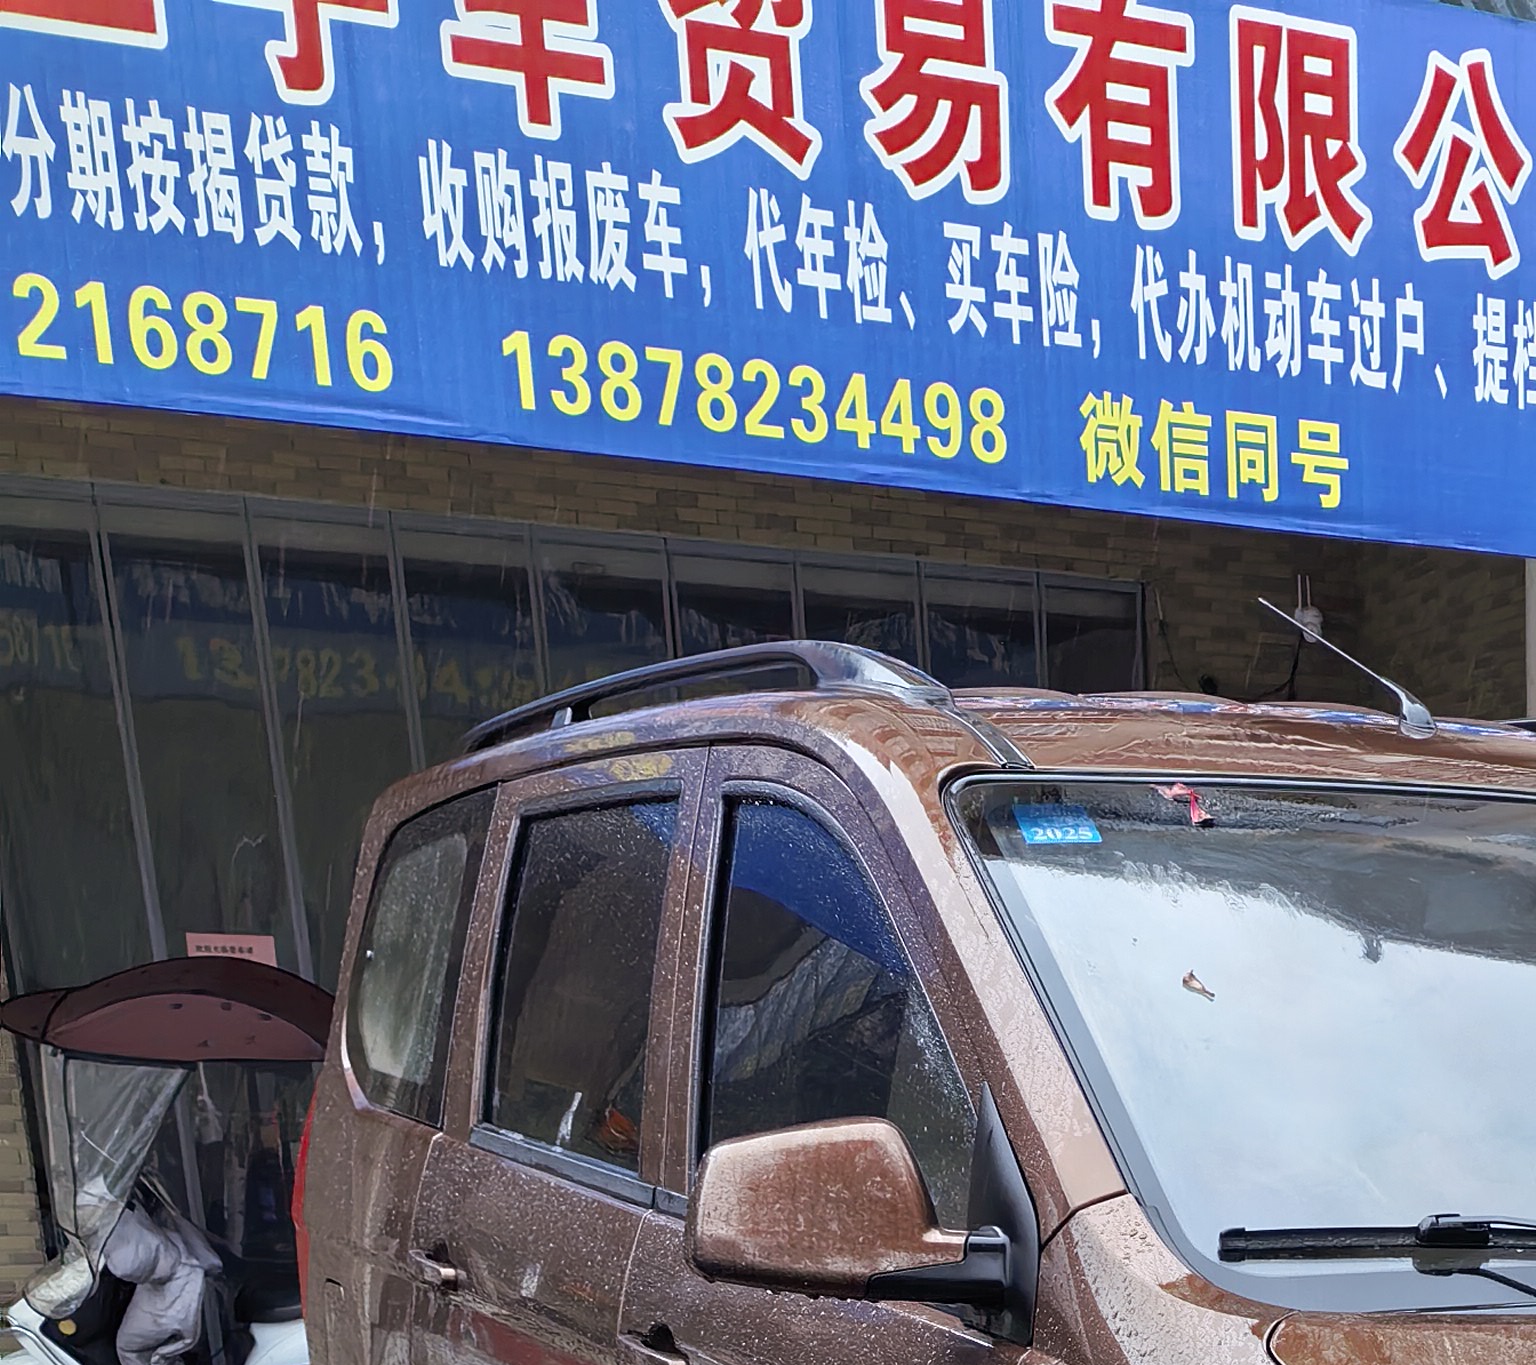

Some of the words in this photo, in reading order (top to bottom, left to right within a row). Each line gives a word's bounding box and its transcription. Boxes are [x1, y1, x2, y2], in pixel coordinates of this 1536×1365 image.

[13, 272, 393, 392] 2168716
[502, 330, 1007, 464] 13878234498
[1080, 390, 1350, 508] 微信同号
[1030, 826, 1094, 841] 2025
